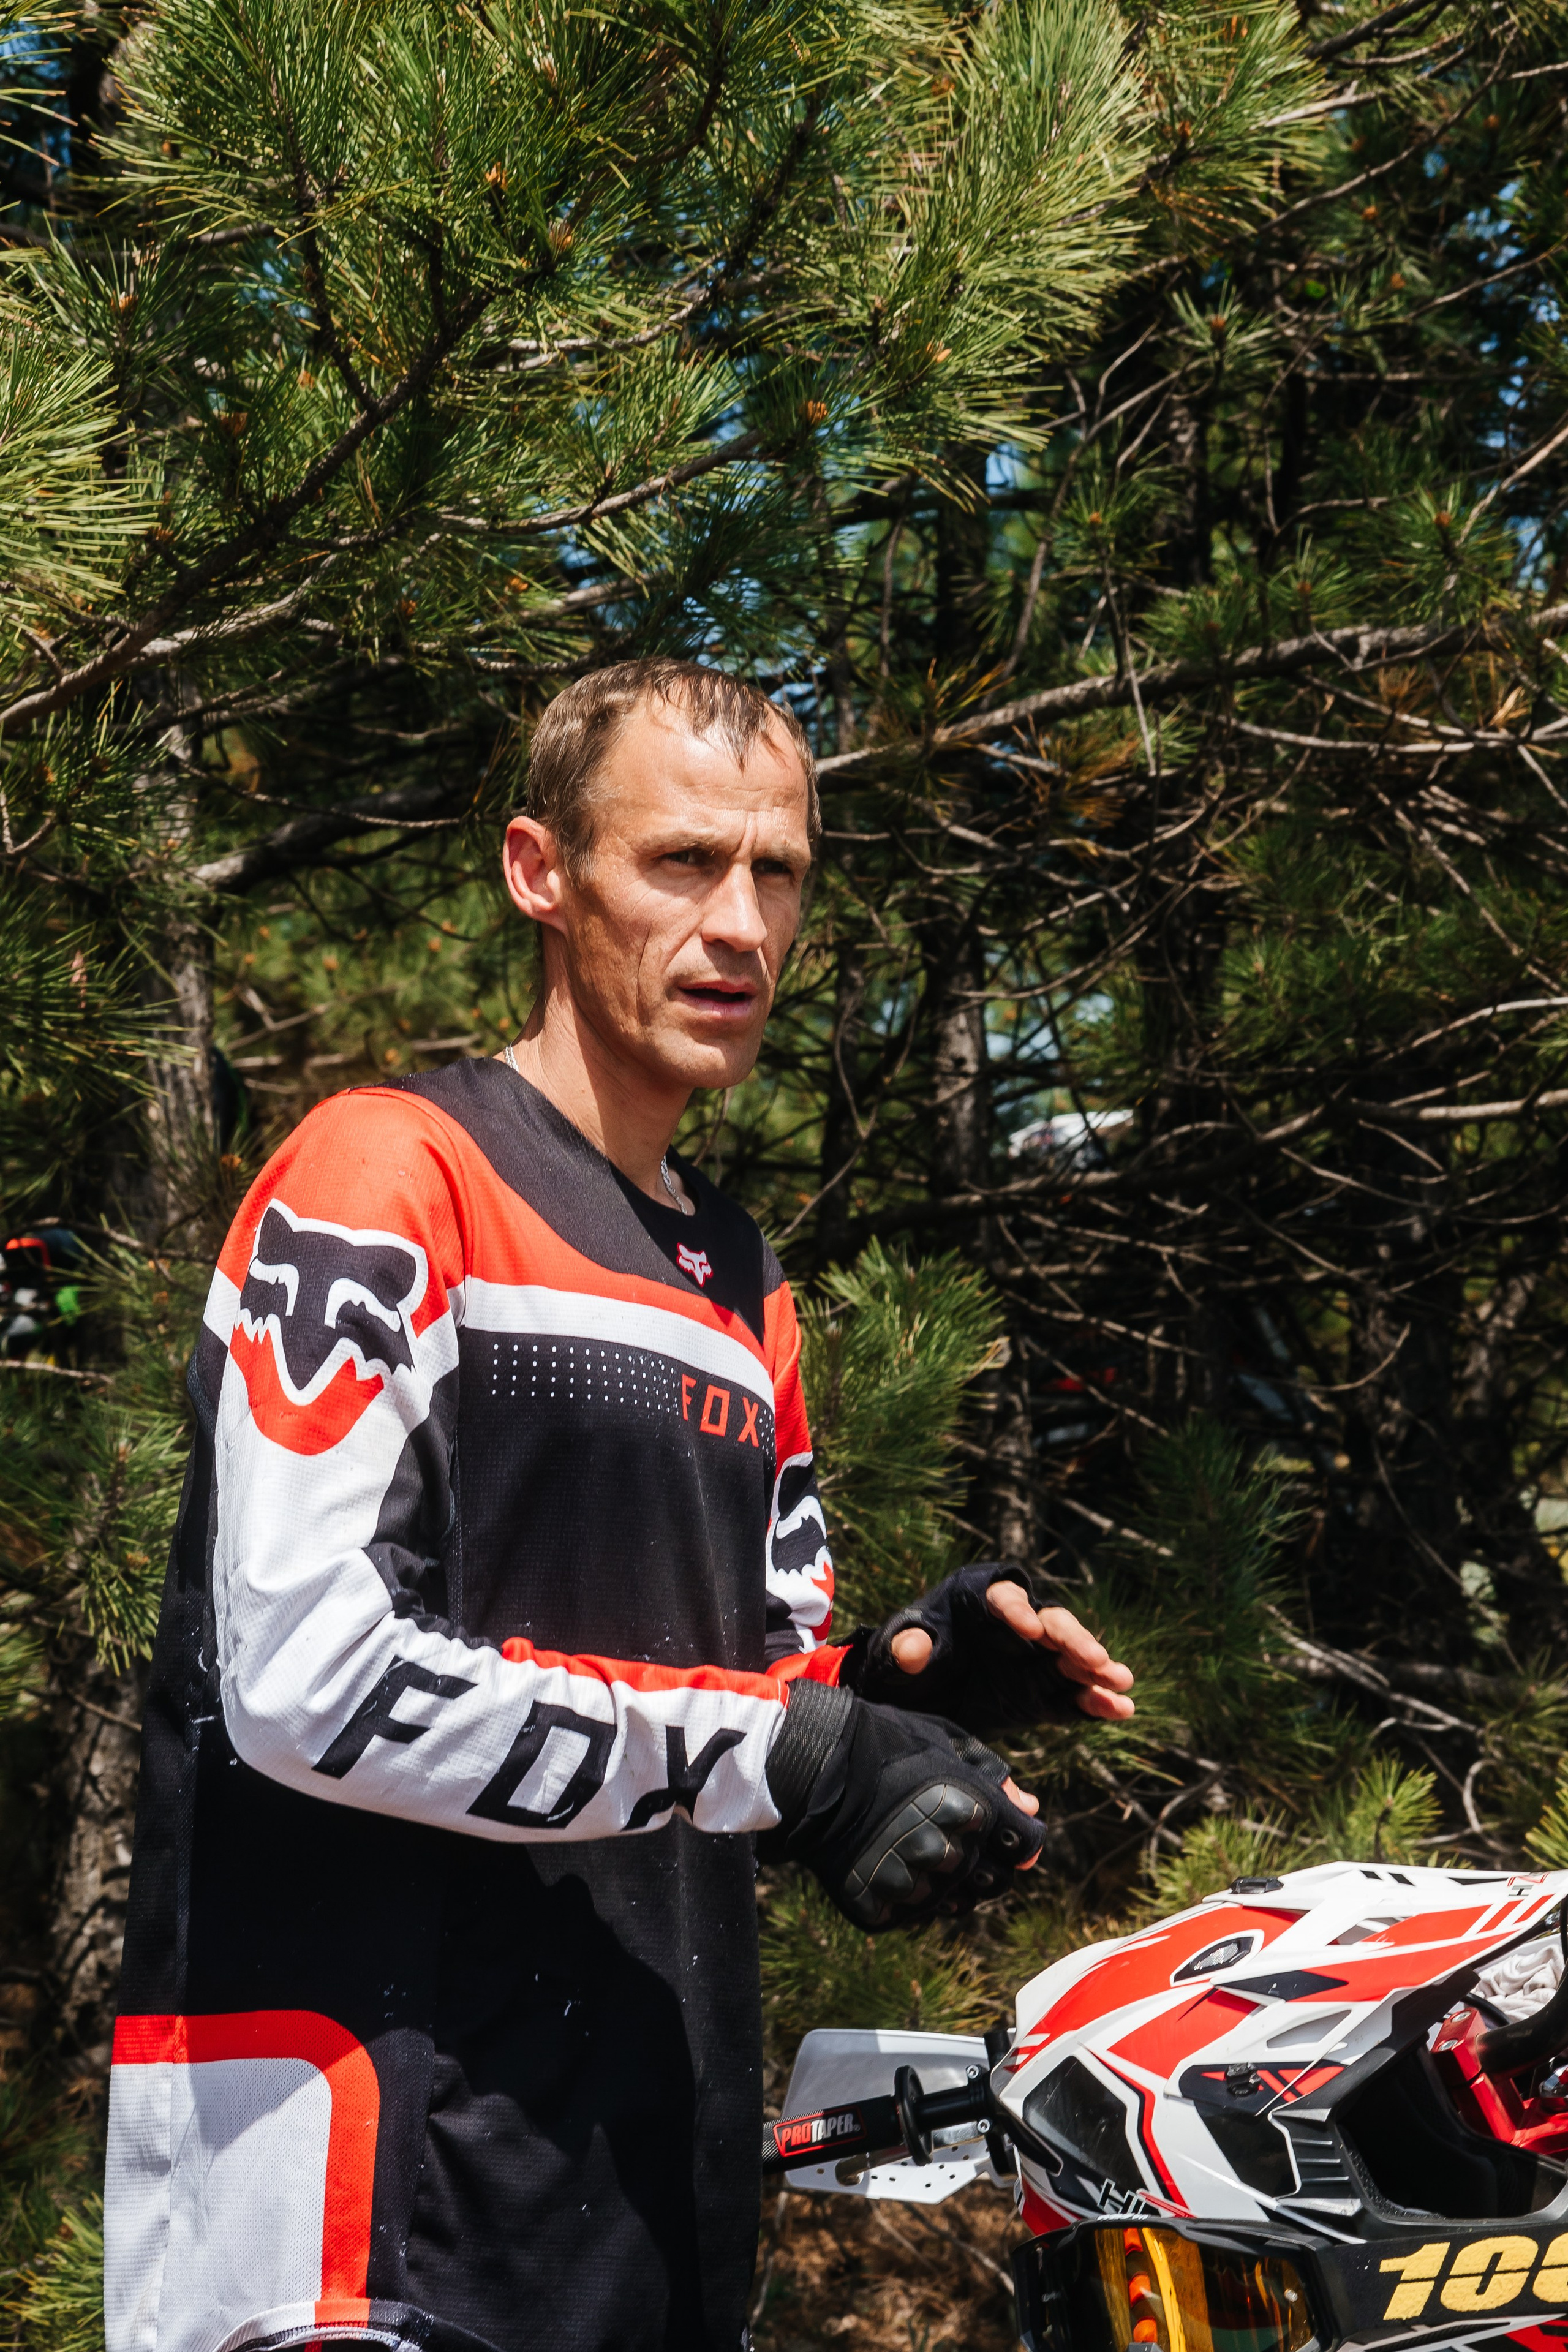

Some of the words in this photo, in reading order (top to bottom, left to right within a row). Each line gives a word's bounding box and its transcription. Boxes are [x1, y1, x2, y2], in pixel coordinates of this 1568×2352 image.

[681, 1374, 759, 1447] FOX
[311, 1655, 747, 1831] FOX
[781, 2113, 854, 2148] PROTAPER
